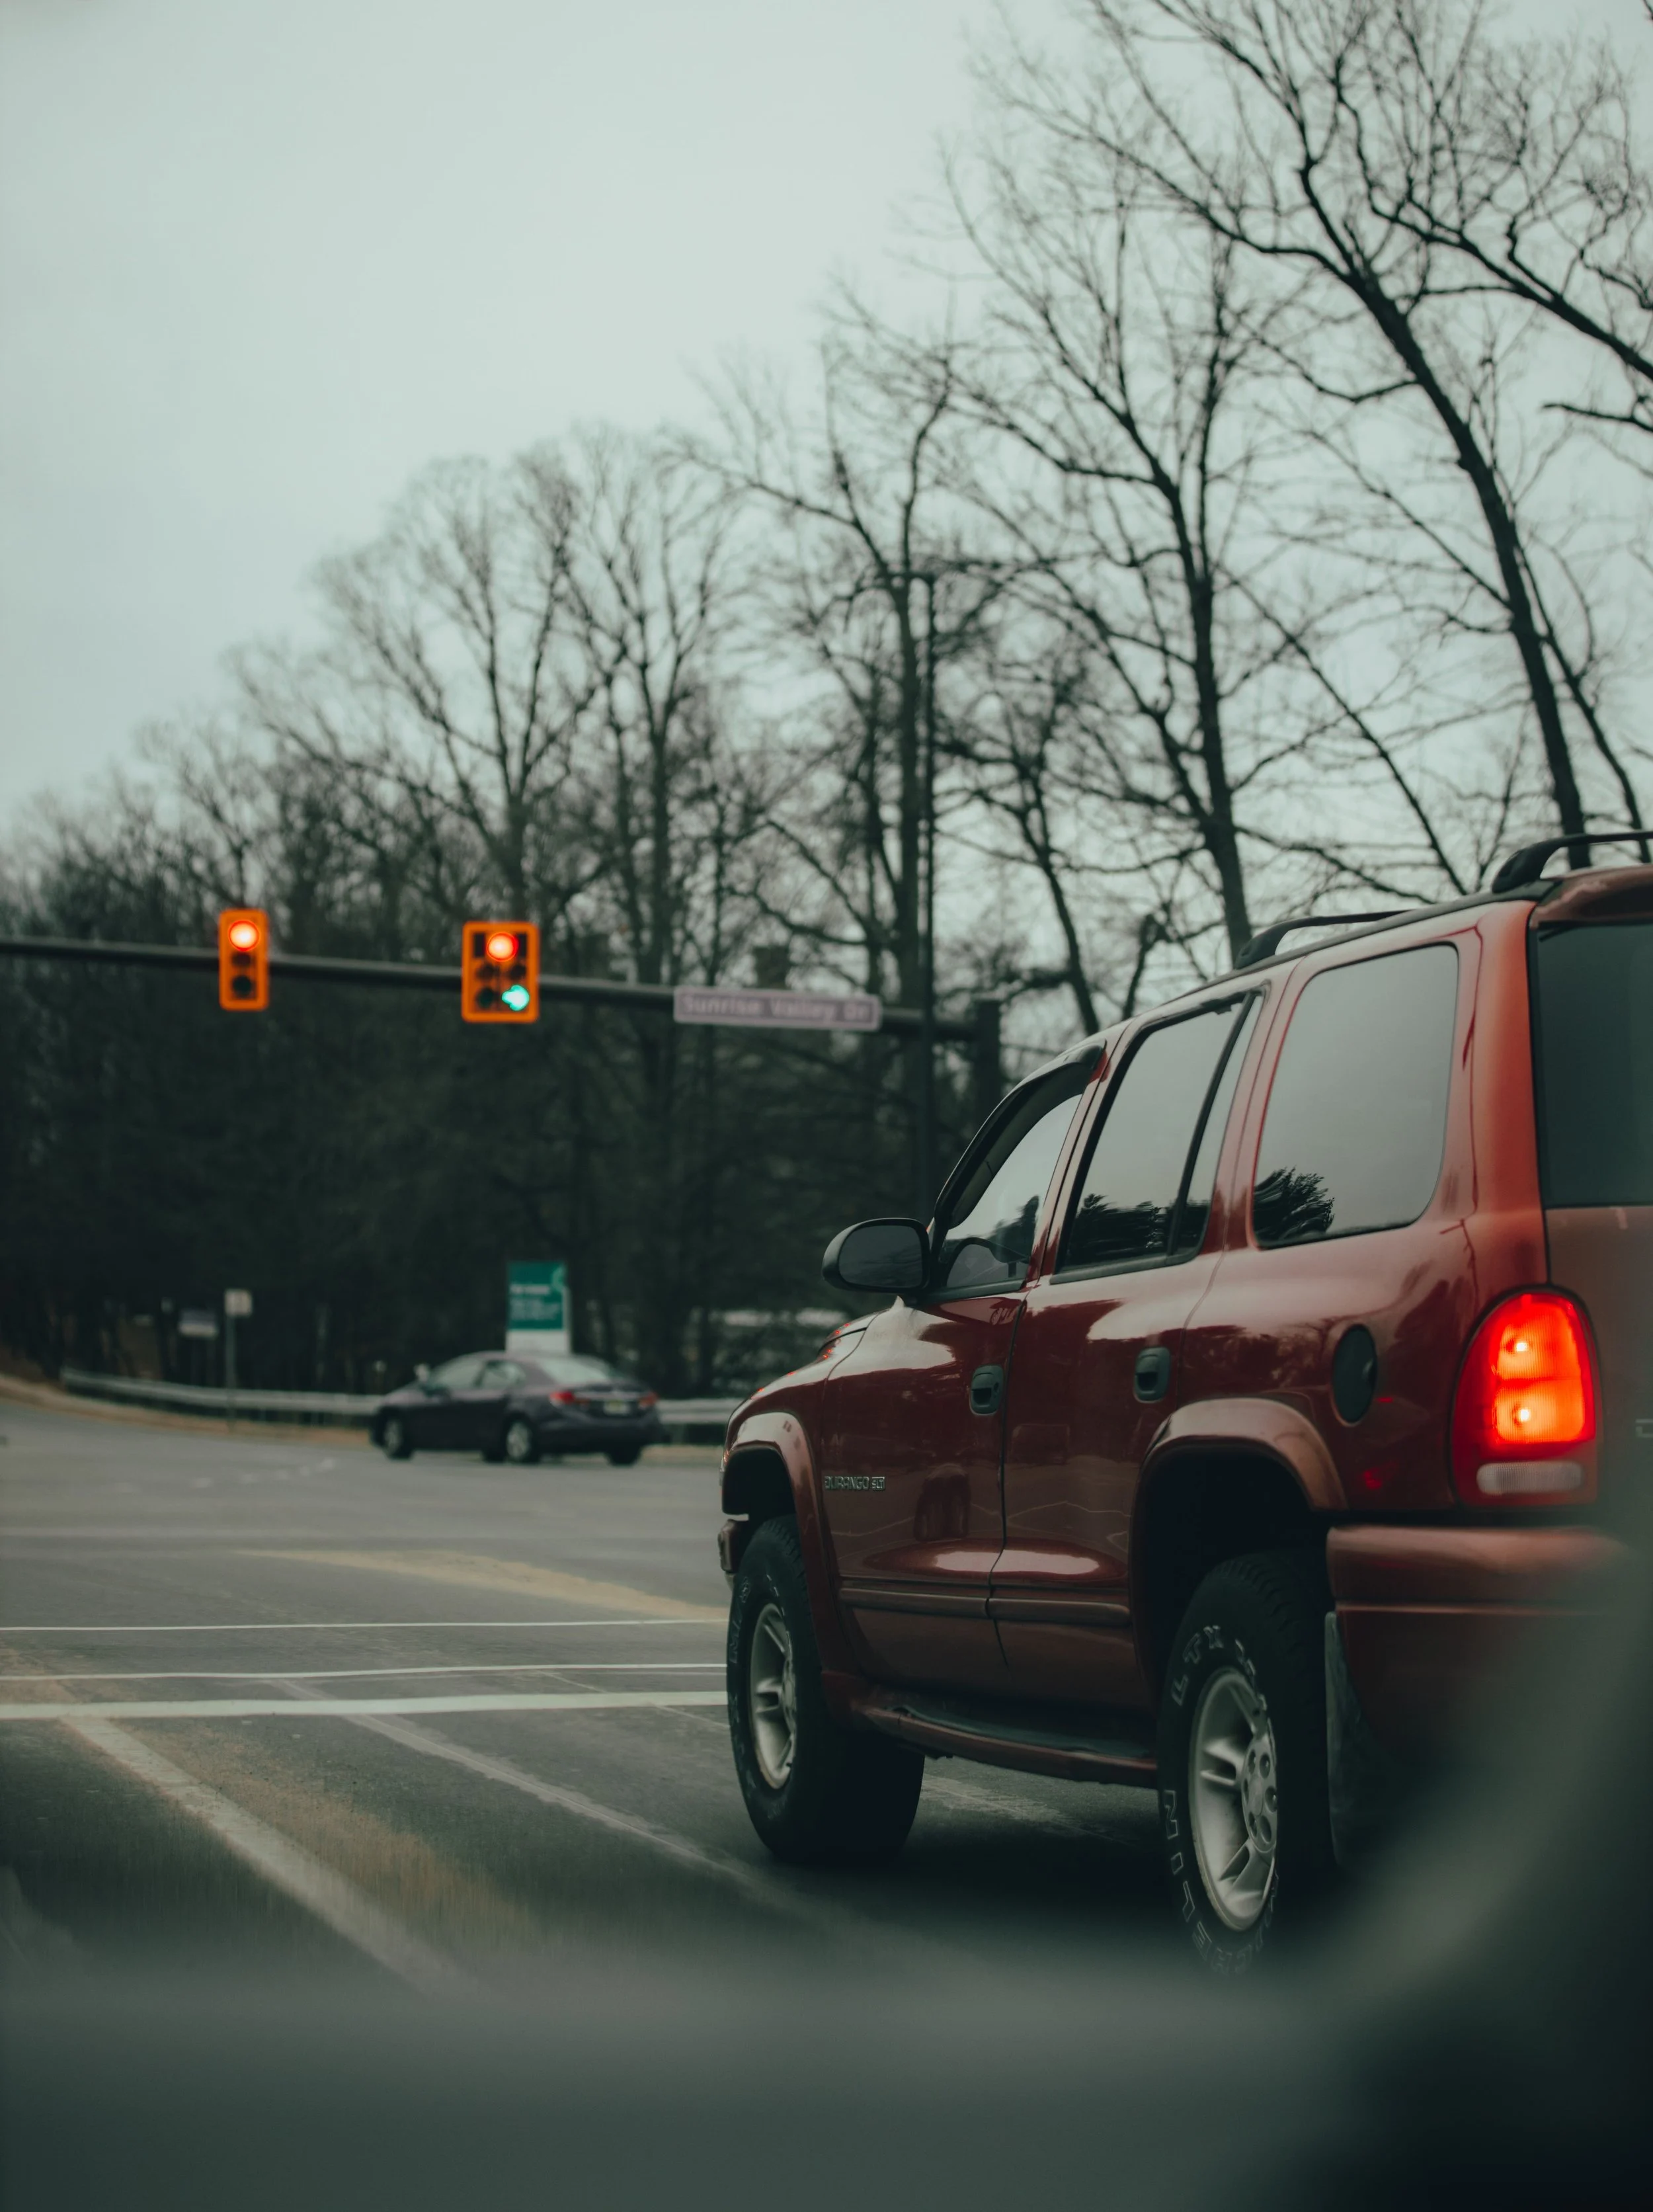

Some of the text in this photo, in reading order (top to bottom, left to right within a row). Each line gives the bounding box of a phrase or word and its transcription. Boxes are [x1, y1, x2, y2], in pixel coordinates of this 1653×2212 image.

[682, 995, 869, 1023] Sunrise Valley Dr
[824, 1475, 869, 1490] DURANGO
[1171, 1624, 1225, 1706] LTX
